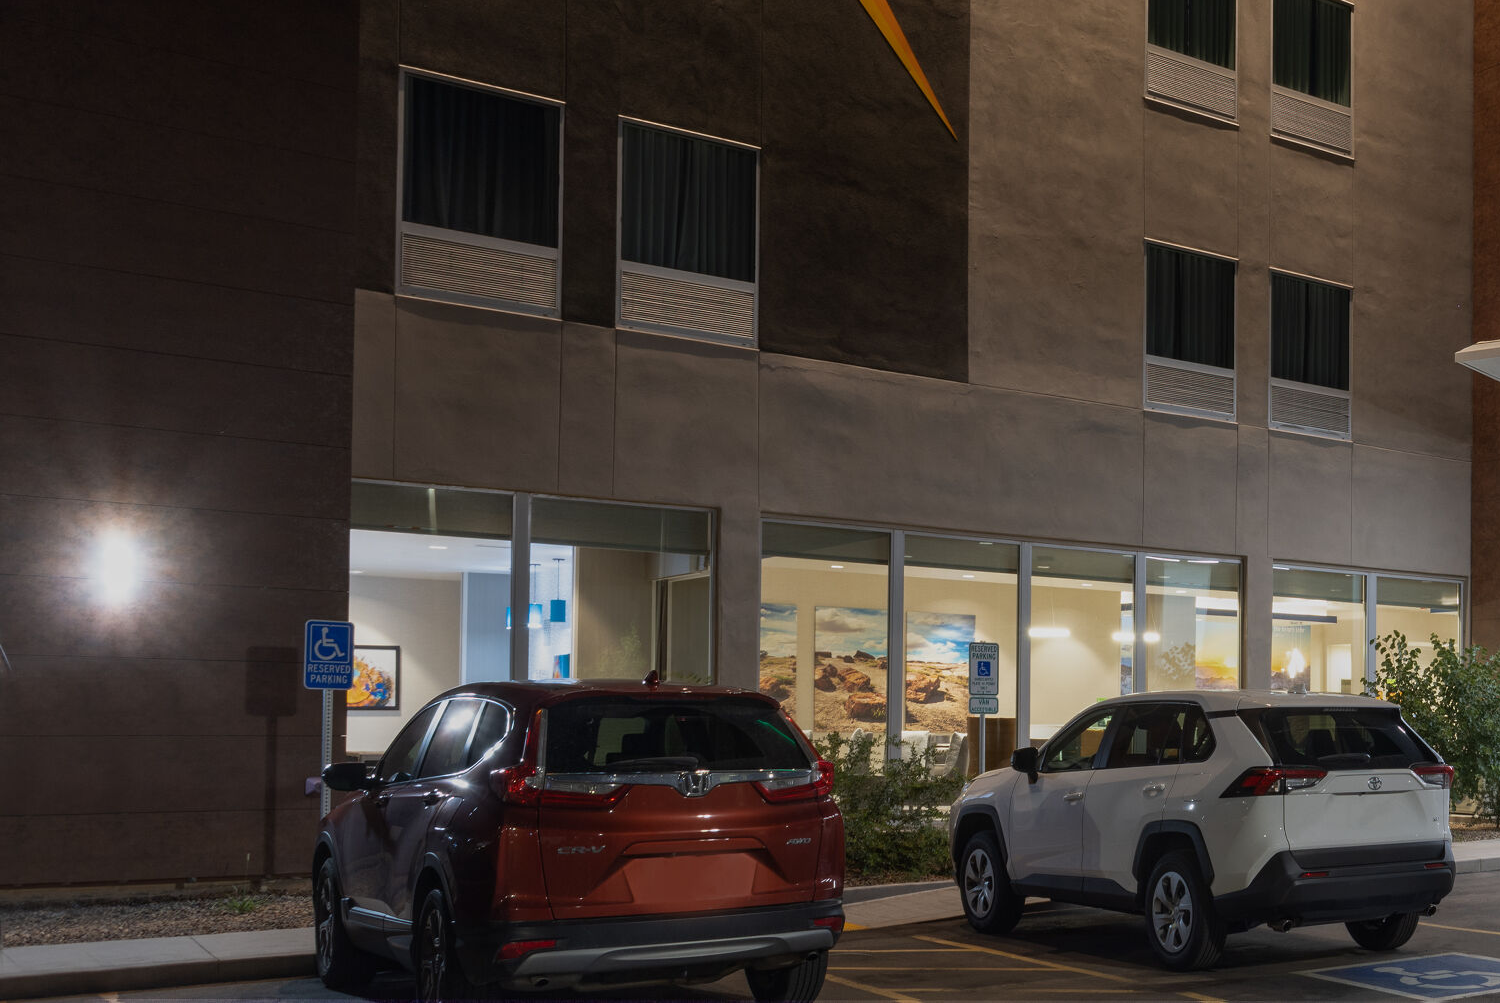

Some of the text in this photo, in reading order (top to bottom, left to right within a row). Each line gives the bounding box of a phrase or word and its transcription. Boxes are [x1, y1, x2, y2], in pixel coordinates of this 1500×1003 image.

[971, 645, 997, 653] RESERVED
[972, 652, 996, 660] PARKING
[307, 663, 351, 674] RESERVED
[310, 674, 348, 684] PARKING
[557, 845, 606, 854] CR-V
